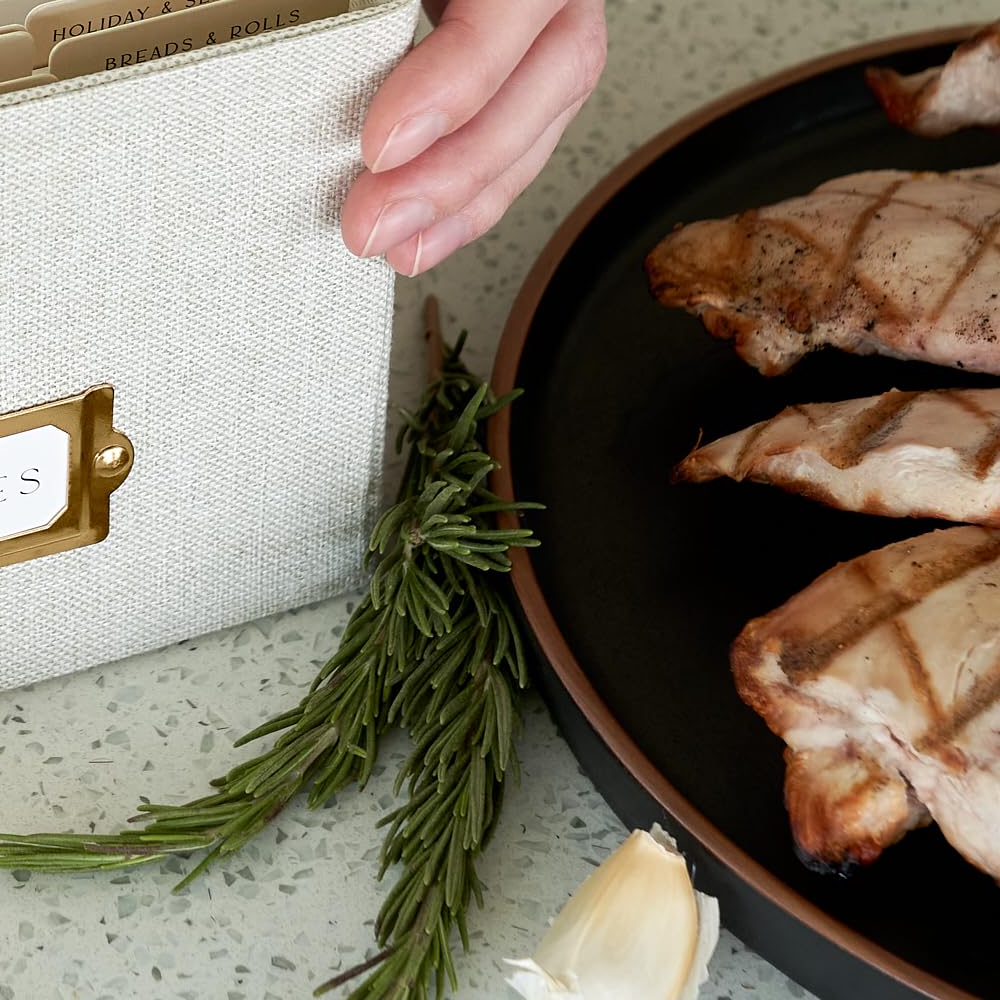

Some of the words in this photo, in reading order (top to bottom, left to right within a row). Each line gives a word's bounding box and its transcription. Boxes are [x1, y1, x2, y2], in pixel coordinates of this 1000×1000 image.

[53, 6, 150, 42] HOLIDAY
[161, 0, 173, 15] &
[105, 37, 193, 71] BREADS
[206, 31, 217, 46] &
[230, 9, 301, 40] ROLLS
